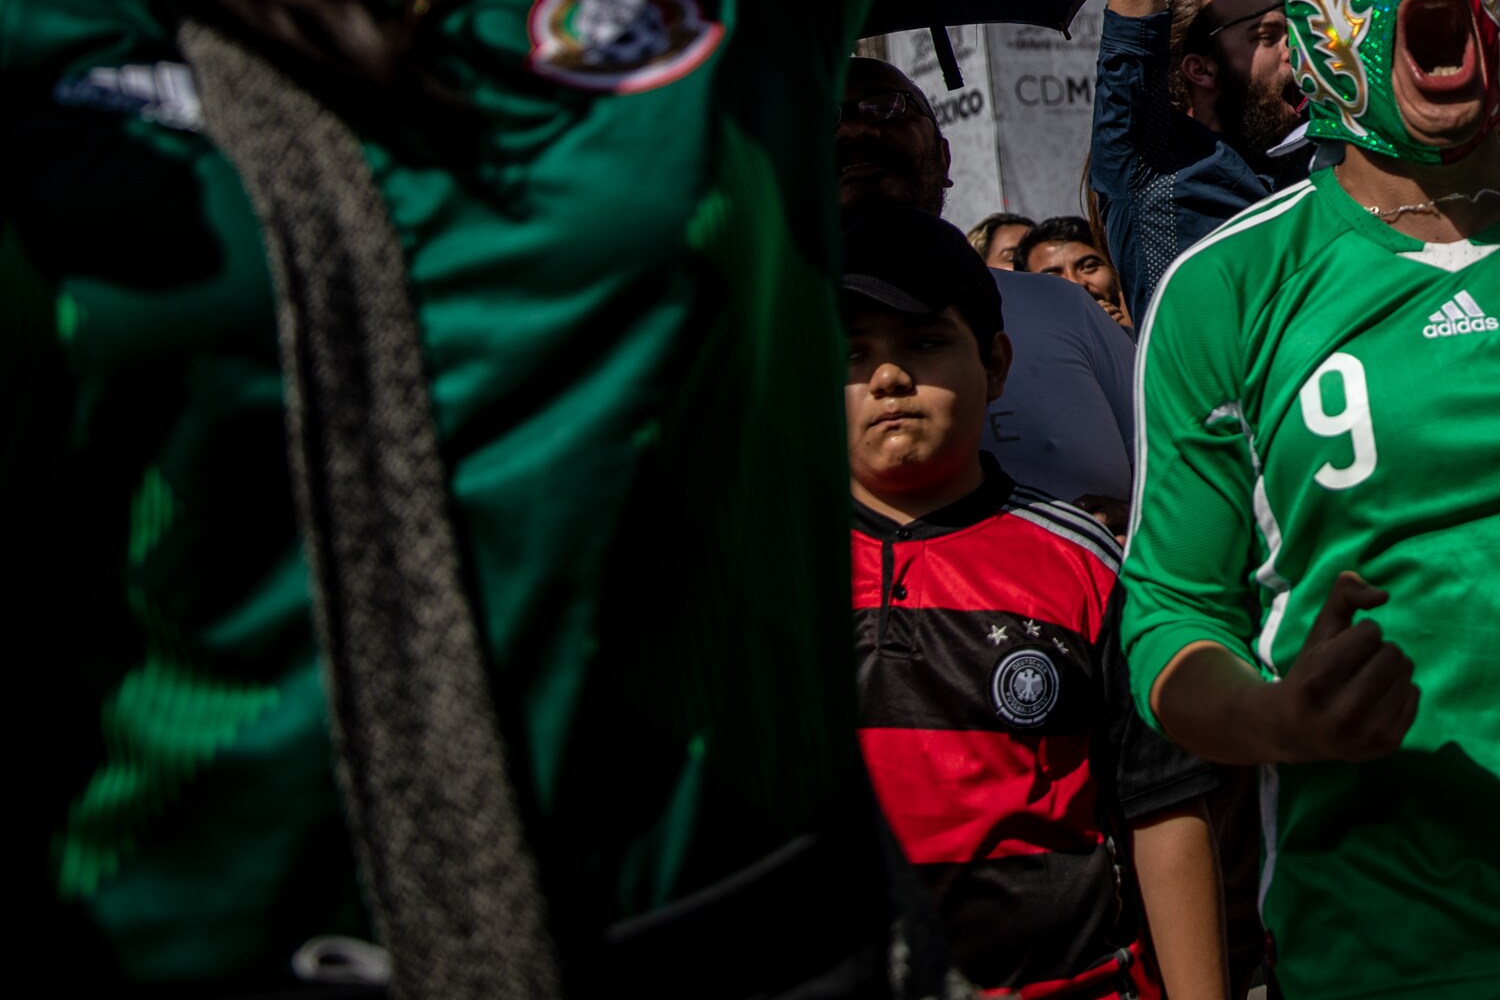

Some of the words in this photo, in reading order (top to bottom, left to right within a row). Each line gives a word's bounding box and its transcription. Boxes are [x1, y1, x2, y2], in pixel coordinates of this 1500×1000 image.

[1014, 74, 1097, 107] CDM
[1422, 316, 1499, 339] adidas
[1299, 352, 1378, 490] 9
[1013, 659, 1048, 674] DEUTSCHER
